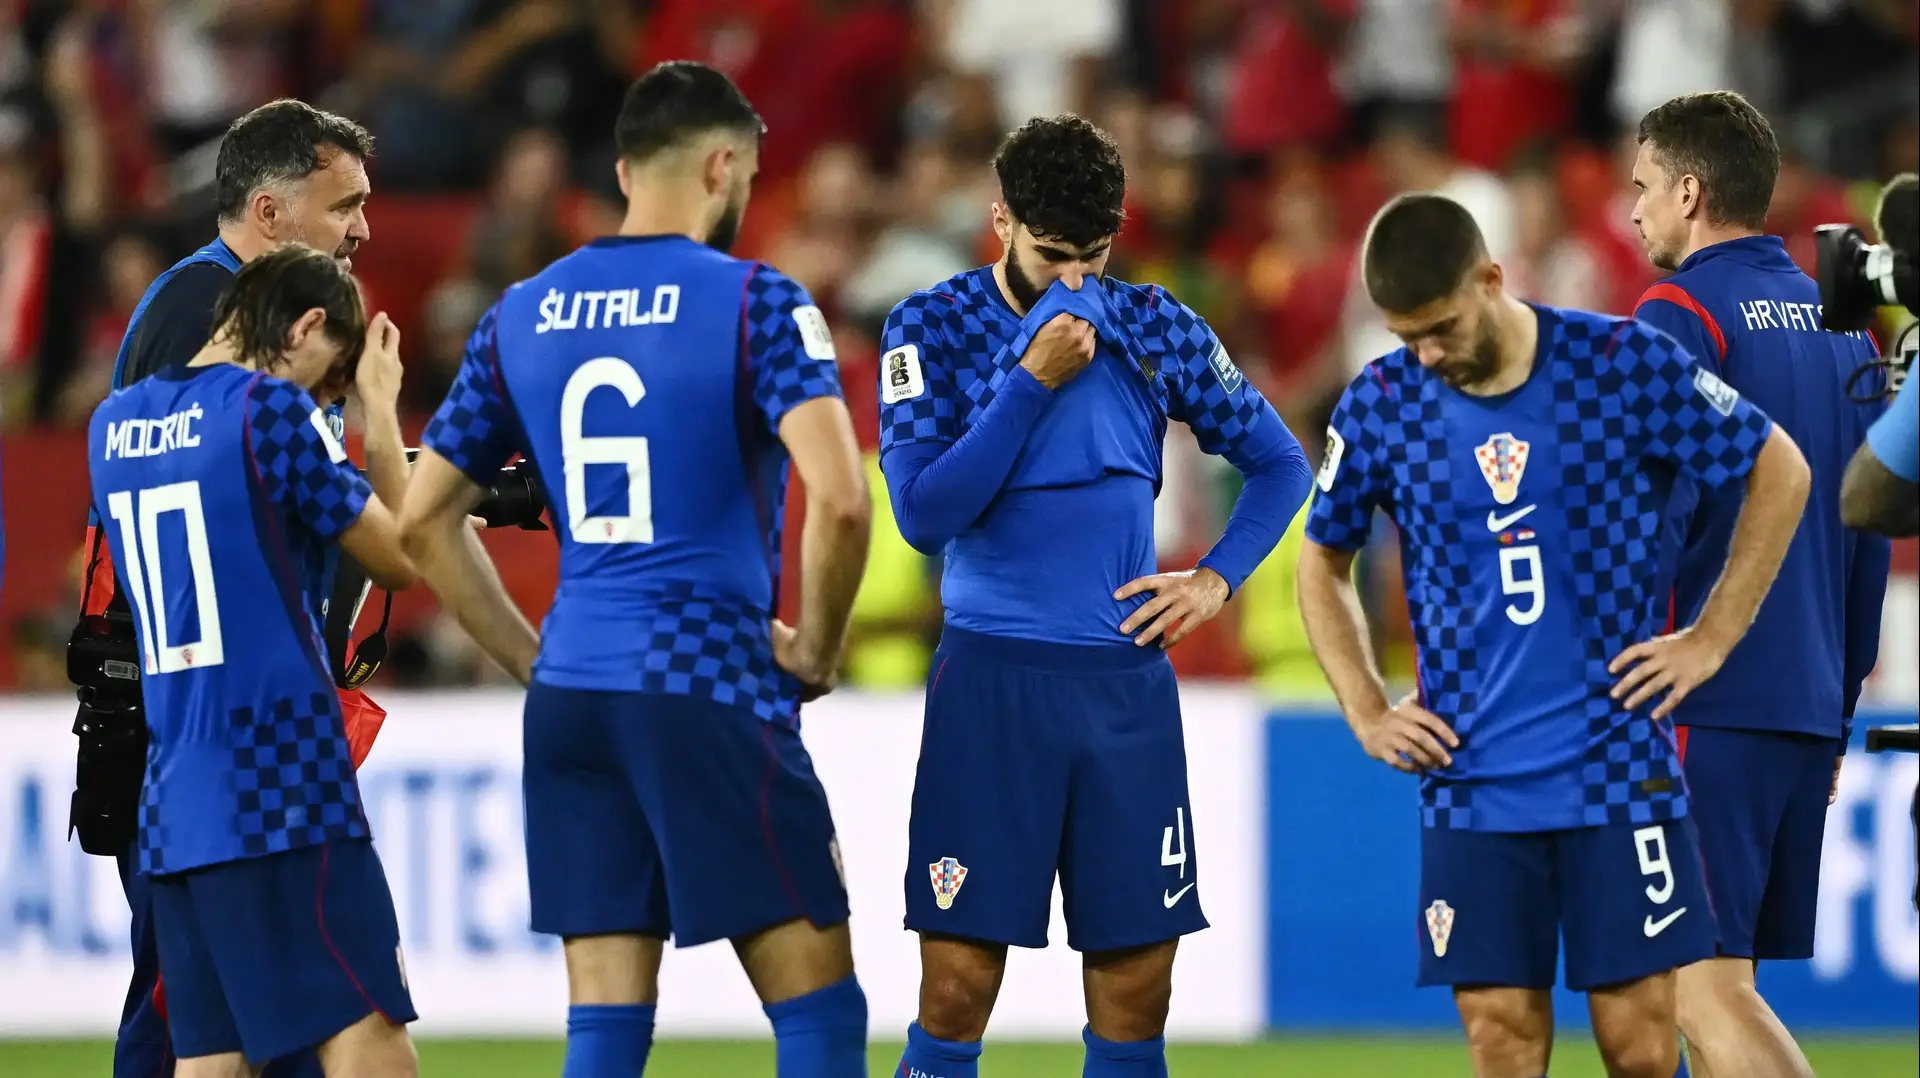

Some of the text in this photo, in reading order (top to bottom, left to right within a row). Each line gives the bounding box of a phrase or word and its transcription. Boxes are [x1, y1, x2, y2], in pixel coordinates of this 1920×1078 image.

[1739, 299, 1861, 340] HRVAT
[104, 401, 203, 461] MODRIĆ
[560, 356, 654, 544] 6
[108, 480, 224, 676] 10
[1498, 545, 1546, 626] 9
[1160, 806, 1188, 879] 4
[1632, 824, 1676, 905] 9
